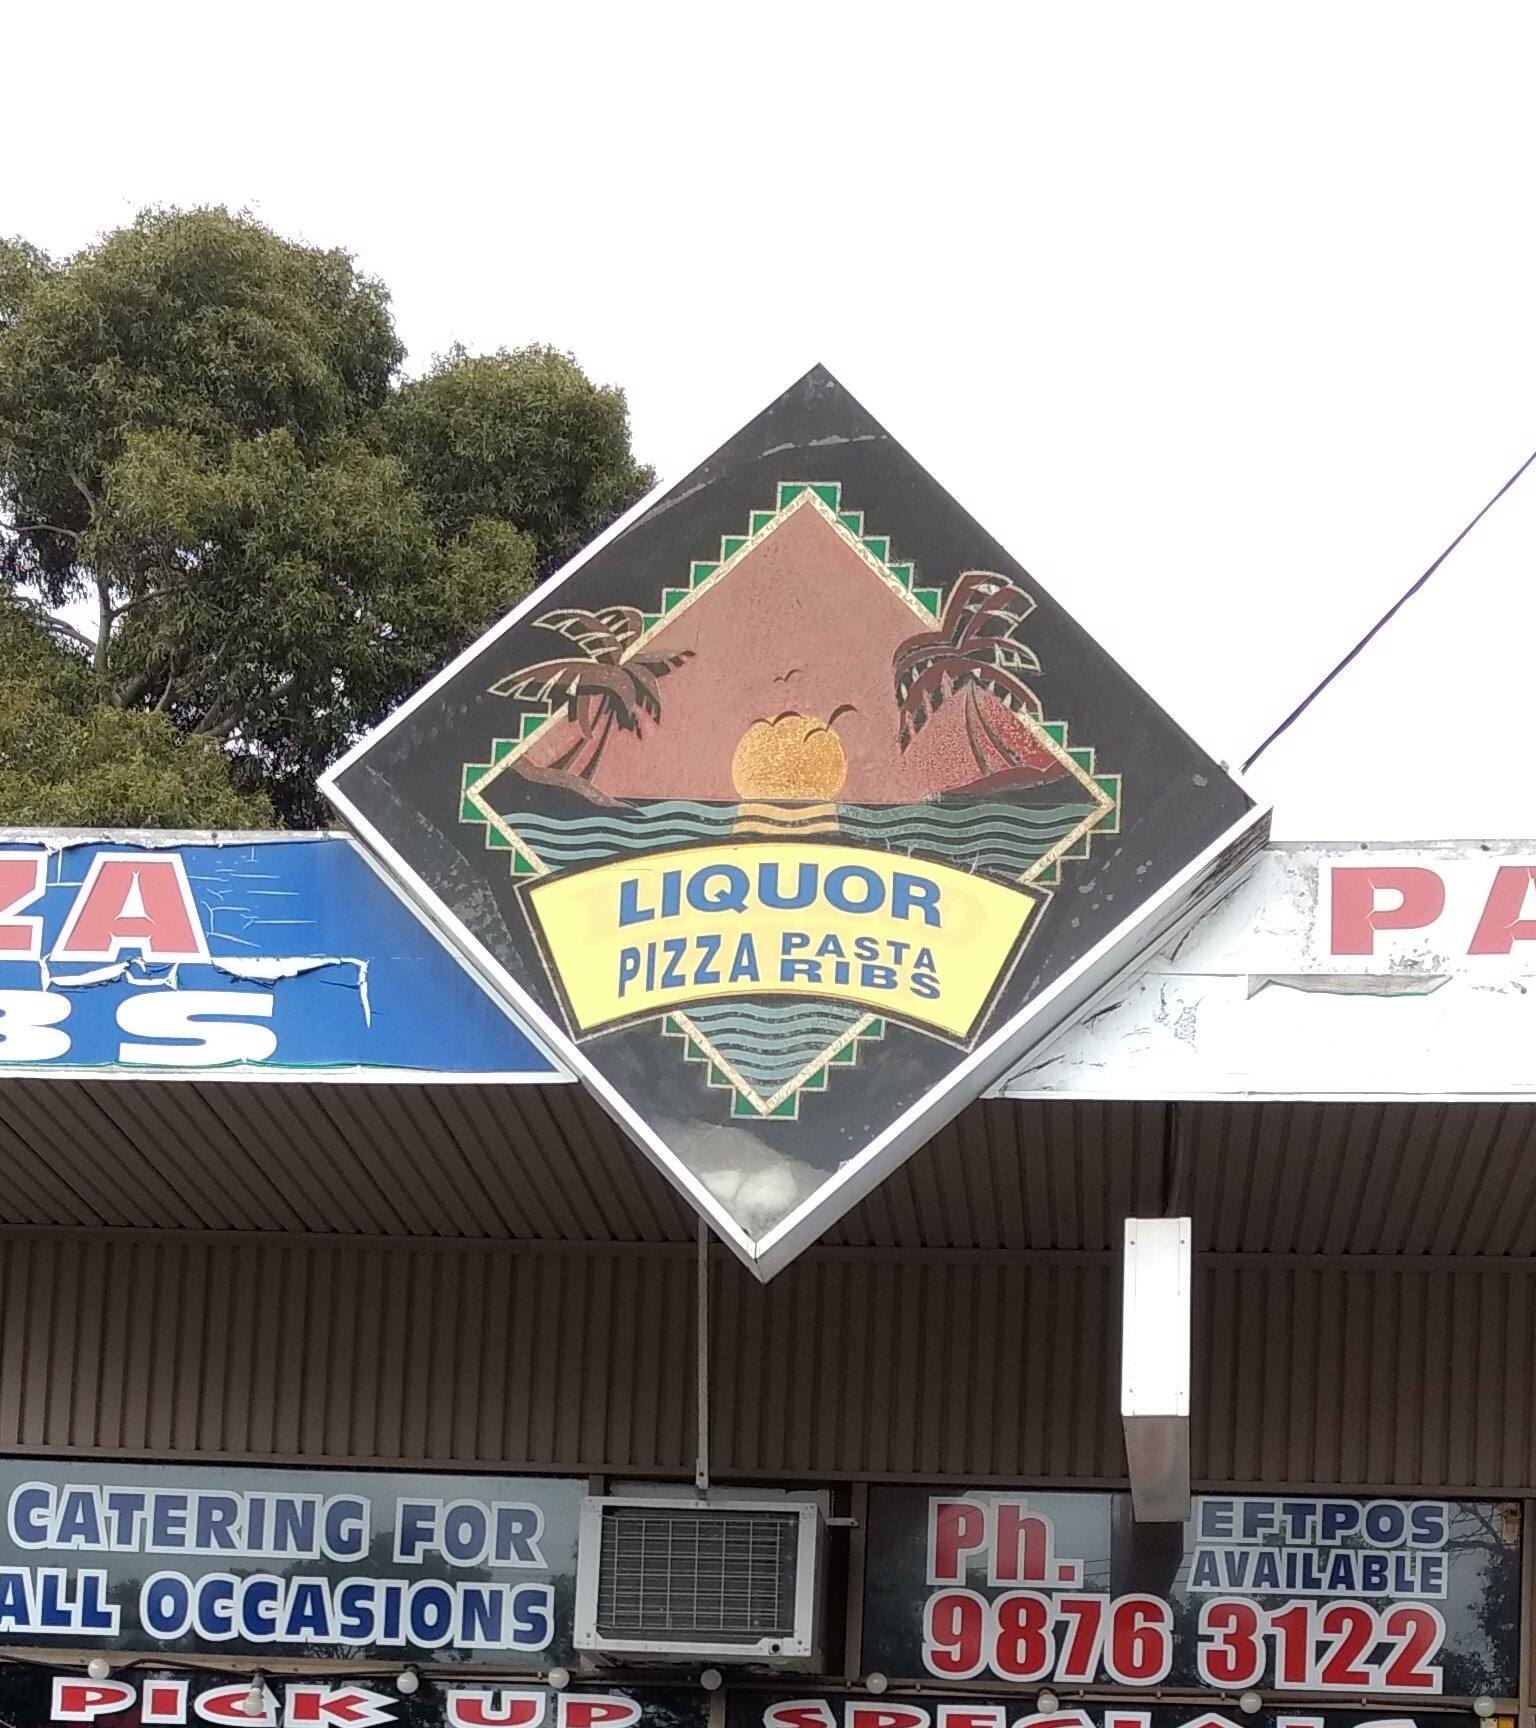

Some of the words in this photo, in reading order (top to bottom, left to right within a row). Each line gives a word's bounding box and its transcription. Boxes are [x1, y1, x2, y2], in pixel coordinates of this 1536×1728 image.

[618, 863, 943, 928] LIQUOR
[618, 932, 761, 998] PIZZA
[780, 958, 941, 1000] RIBS
[781, 932, 937, 973] PASTA
[8, 1481, 368, 1562] CATERING
[393, 1499, 548, 1569] FOR
[927, 1496, 1084, 1586] Ph.
[1194, 1499, 1450, 1549] EFTPOS
[1186, 1545, 1448, 1599] AVAILABLE
[139, 1570, 556, 1652] OCCASIONS
[922, 1588, 1173, 1687] 9876
[1197, 1597, 1445, 1694] 3122
